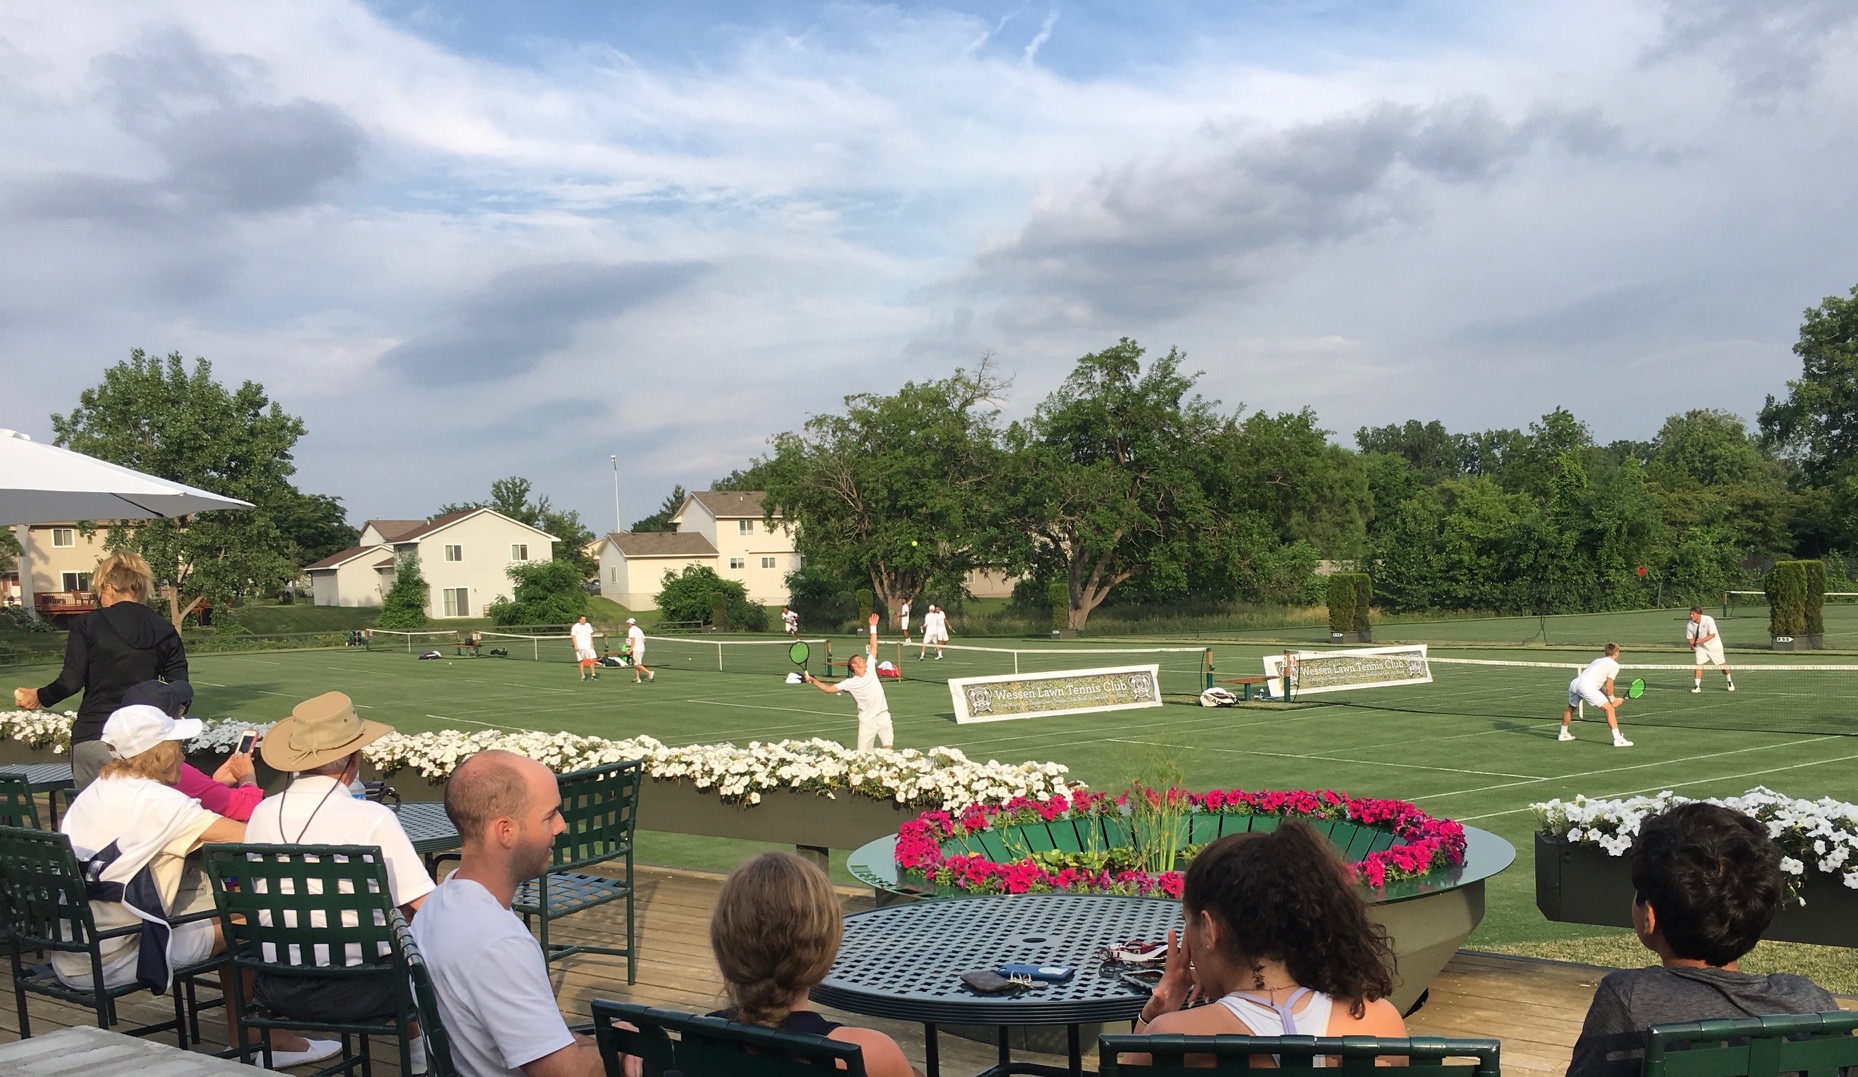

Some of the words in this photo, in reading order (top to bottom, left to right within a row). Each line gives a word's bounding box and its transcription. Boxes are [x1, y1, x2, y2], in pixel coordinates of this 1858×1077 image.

[1300, 666, 1332, 676] Wessen
[1333, 664, 1355, 674] Lawn
[1357, 662, 1383, 672] Tennis
[1384, 659, 1404, 669] Club
[994, 689, 1035, 700] Wessen
[1037, 687, 1064, 698] Lawn
[1066, 683, 1101, 695] Tennis
[1103, 680, 1127, 692] Club
